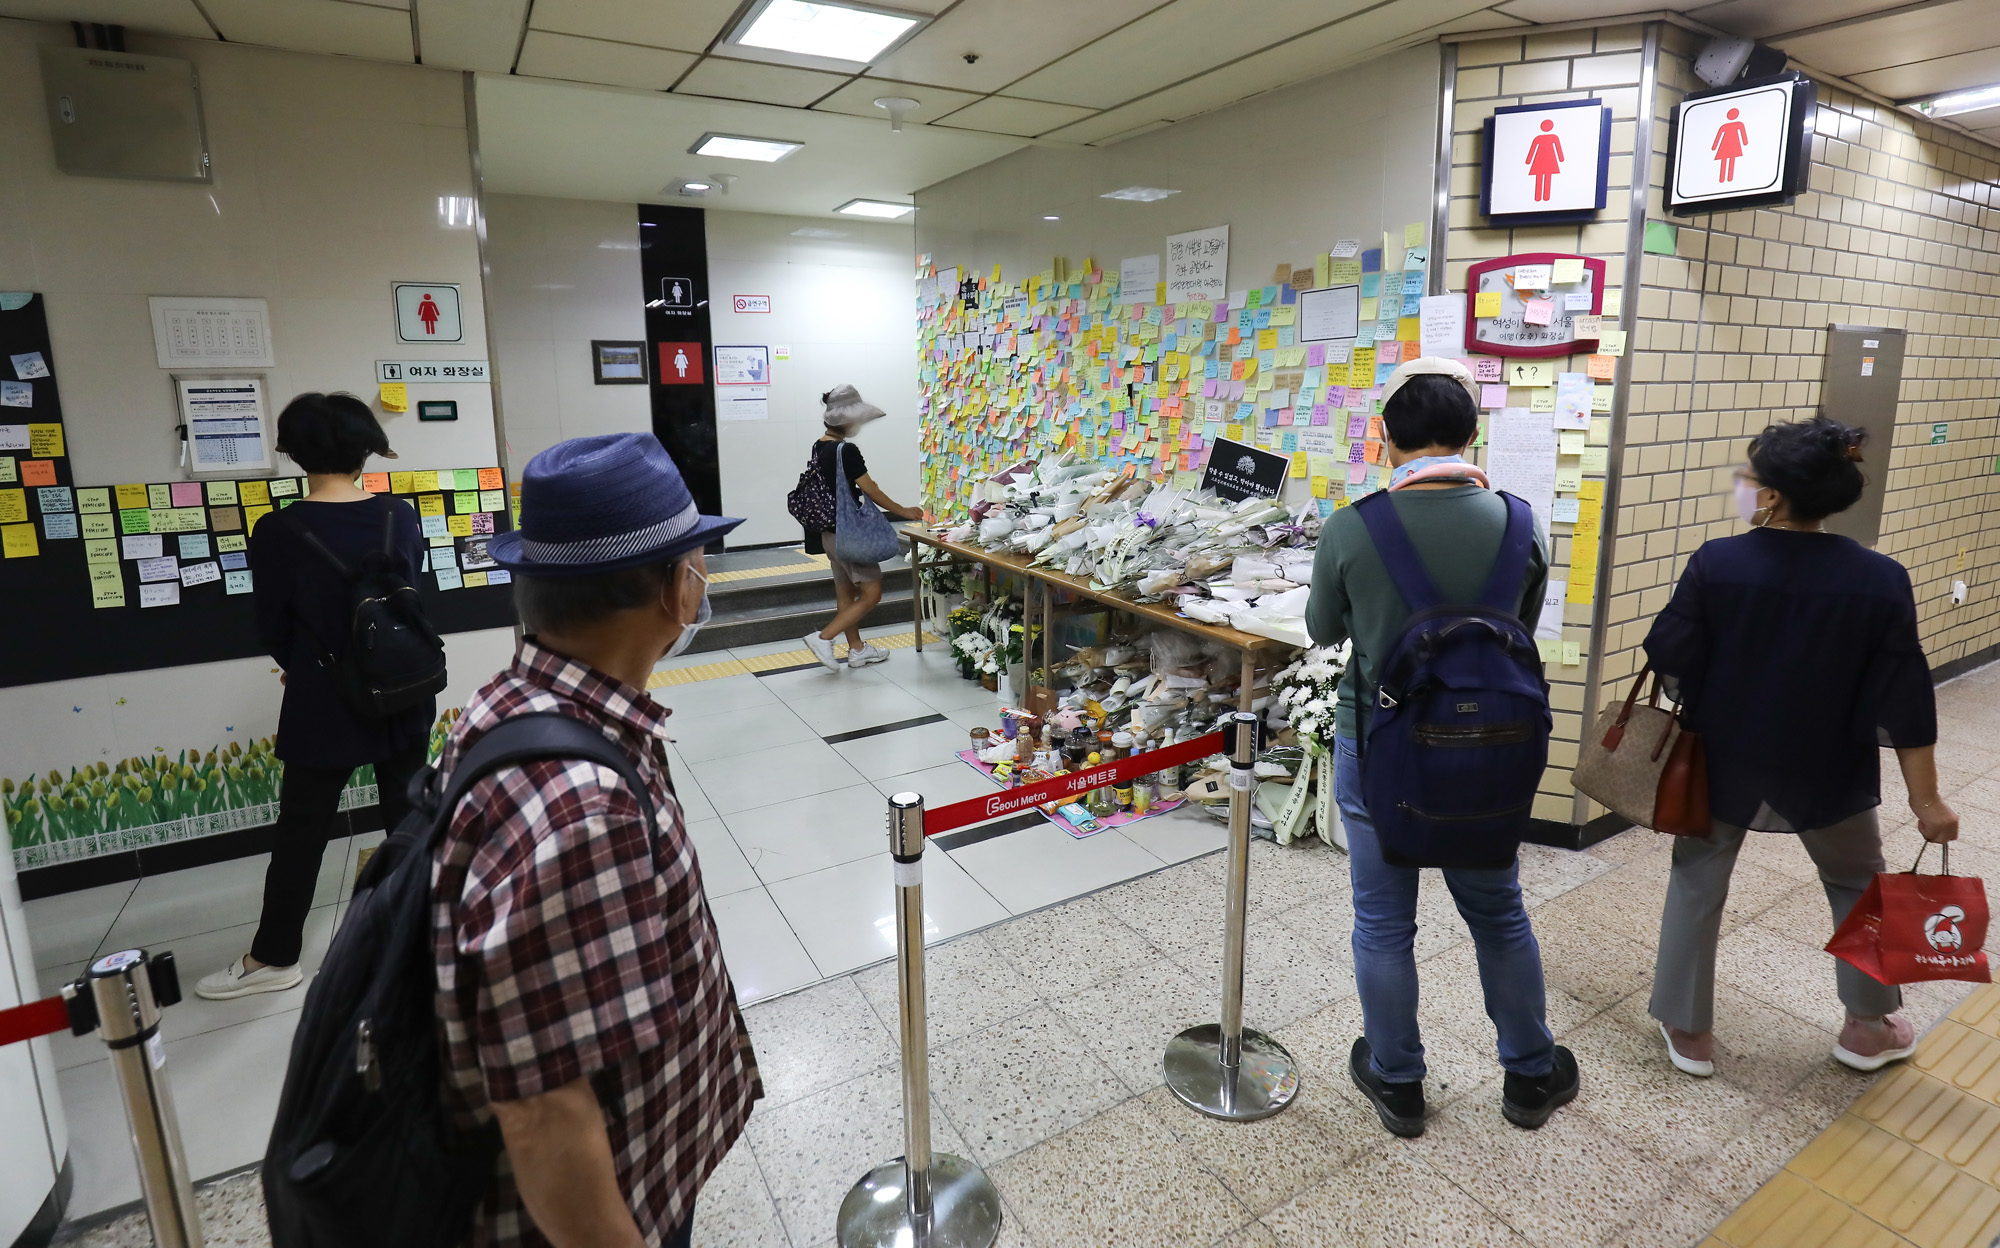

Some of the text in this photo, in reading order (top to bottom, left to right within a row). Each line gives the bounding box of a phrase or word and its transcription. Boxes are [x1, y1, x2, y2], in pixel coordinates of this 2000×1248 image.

[1189, 260, 1213, 275] 공범이다
[1492, 317, 1519, 329] 여성이
[1553, 316, 1574, 328] 서울
[1540, 331, 1566, 341] 화장실
[409, 366, 484, 377] 여자 화장실
[1208, 466, 1218, 476] 막을
[1240, 478, 1255, 489] 막아야
[220, 542, 244, 550] 미안해요
[1066, 768, 1117, 791] 서울메트로
[986, 792, 1047, 816] Seoul Metro
